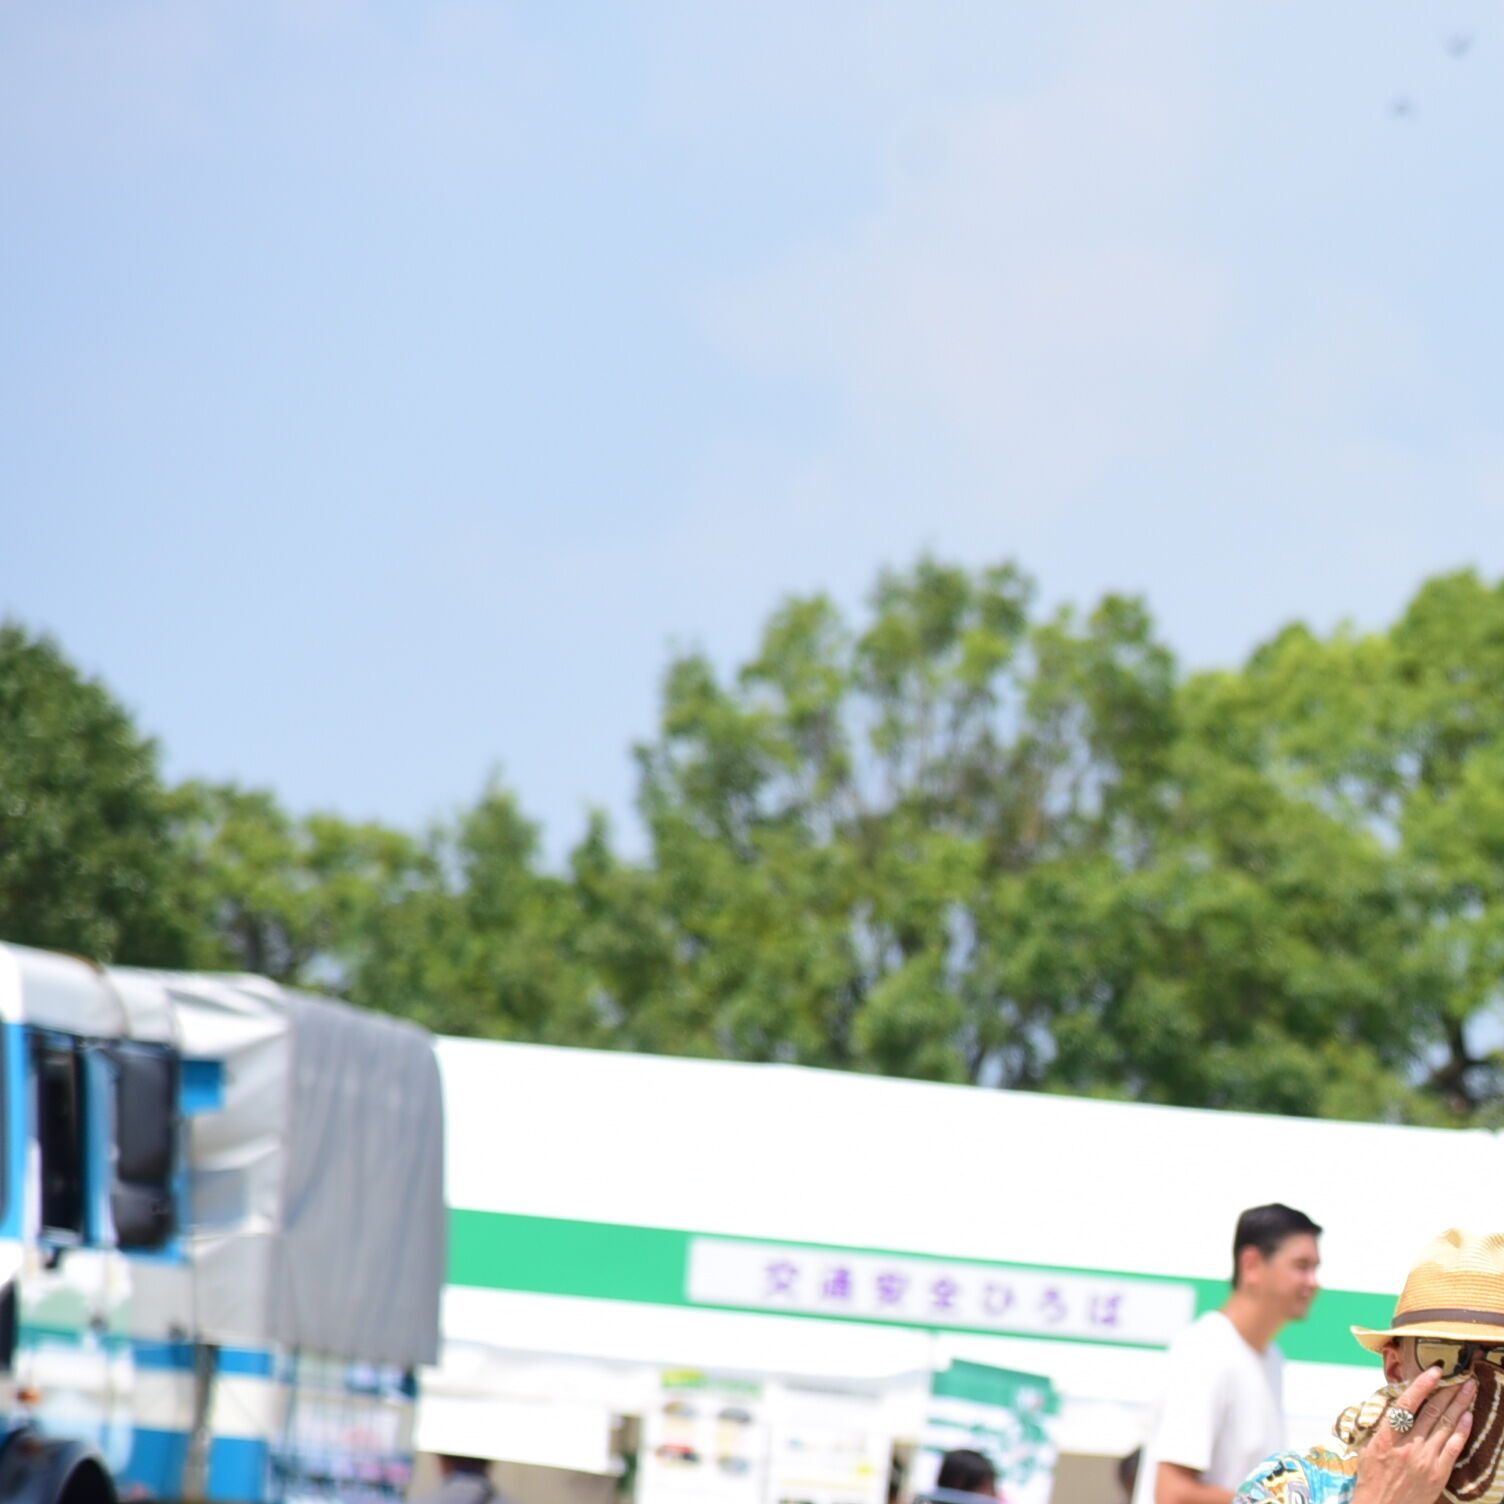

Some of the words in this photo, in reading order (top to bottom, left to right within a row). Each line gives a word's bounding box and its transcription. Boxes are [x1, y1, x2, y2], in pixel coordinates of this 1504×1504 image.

[763, 1259, 1127, 1329] 交通安全ひろば
